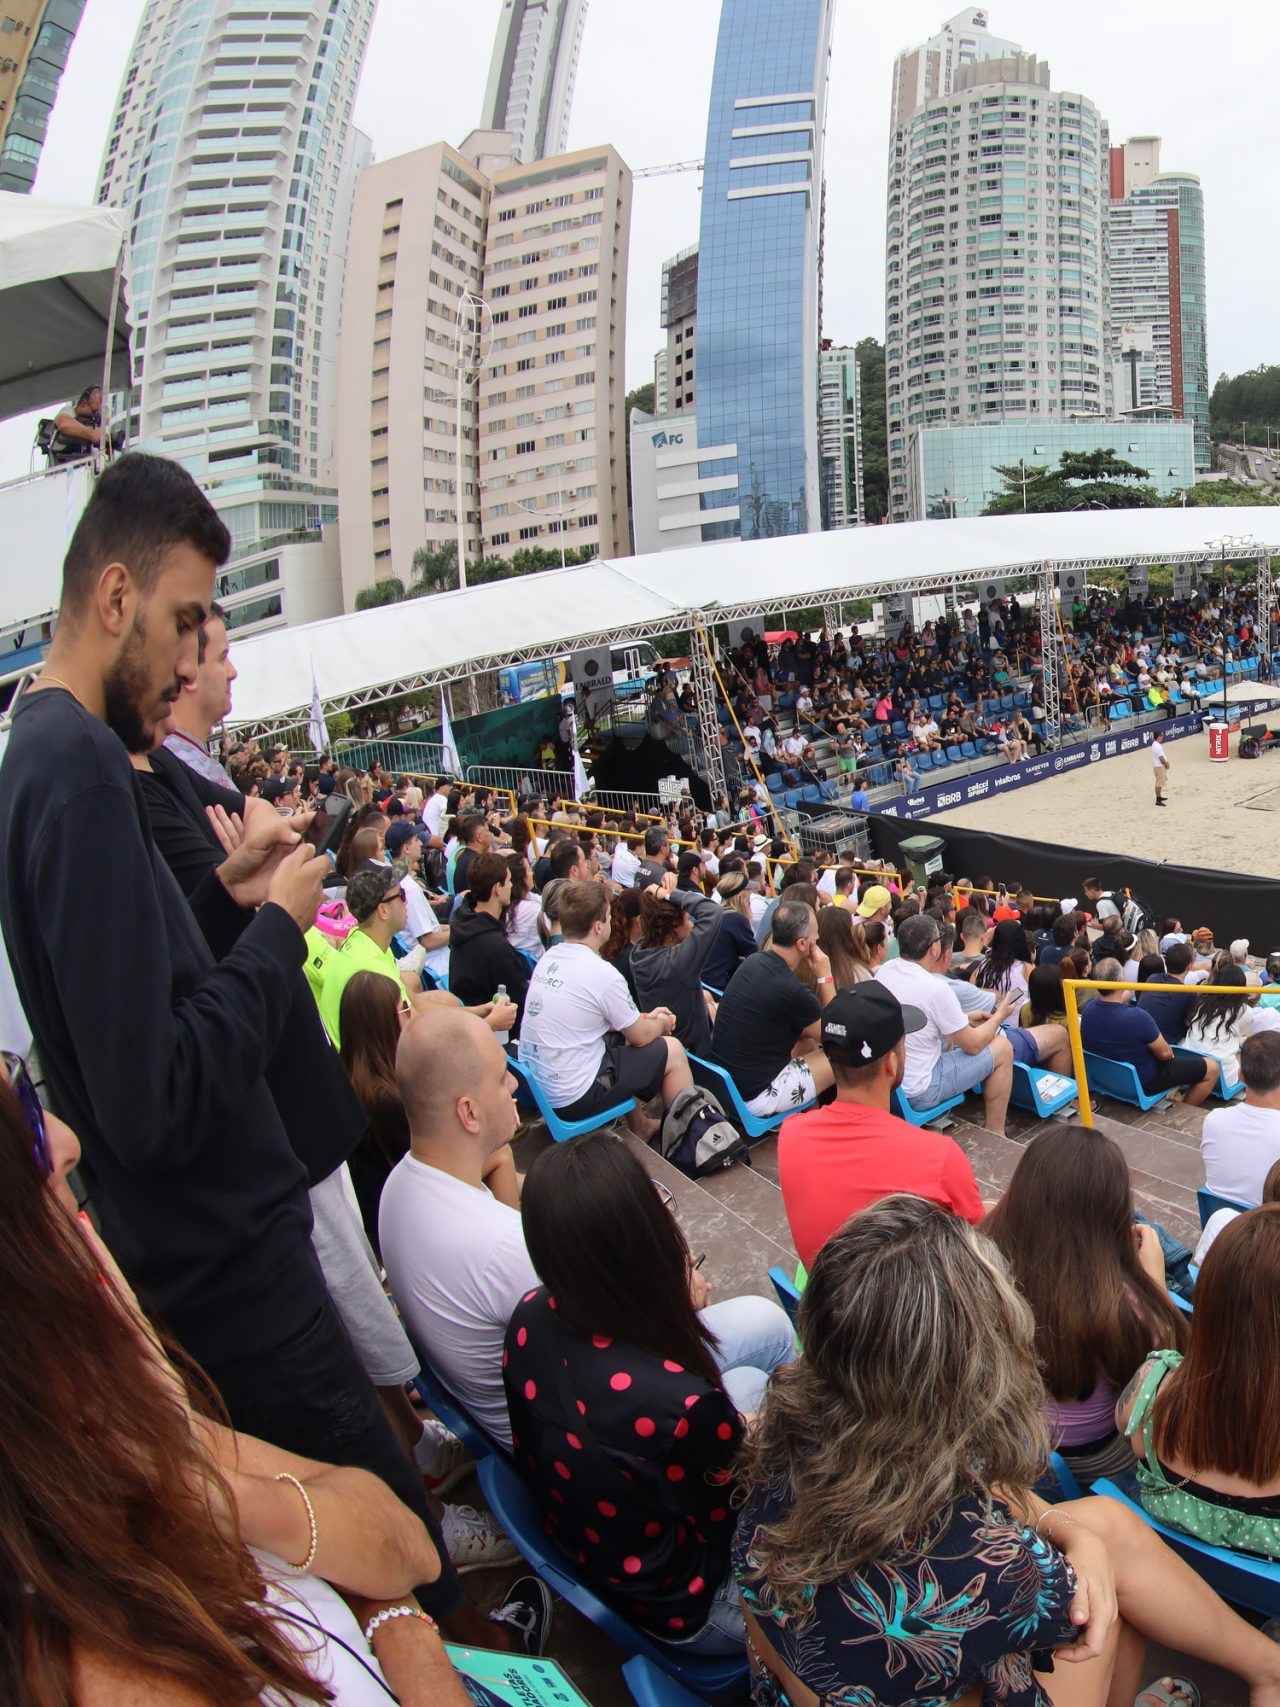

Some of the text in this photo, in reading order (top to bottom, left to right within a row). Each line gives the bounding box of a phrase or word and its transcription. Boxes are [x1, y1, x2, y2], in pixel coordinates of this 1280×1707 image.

[1063, 752, 1085, 763] EMBRAED
[1025, 762, 1049, 774] SANDEVER
[945, 791, 961, 804] BRB
